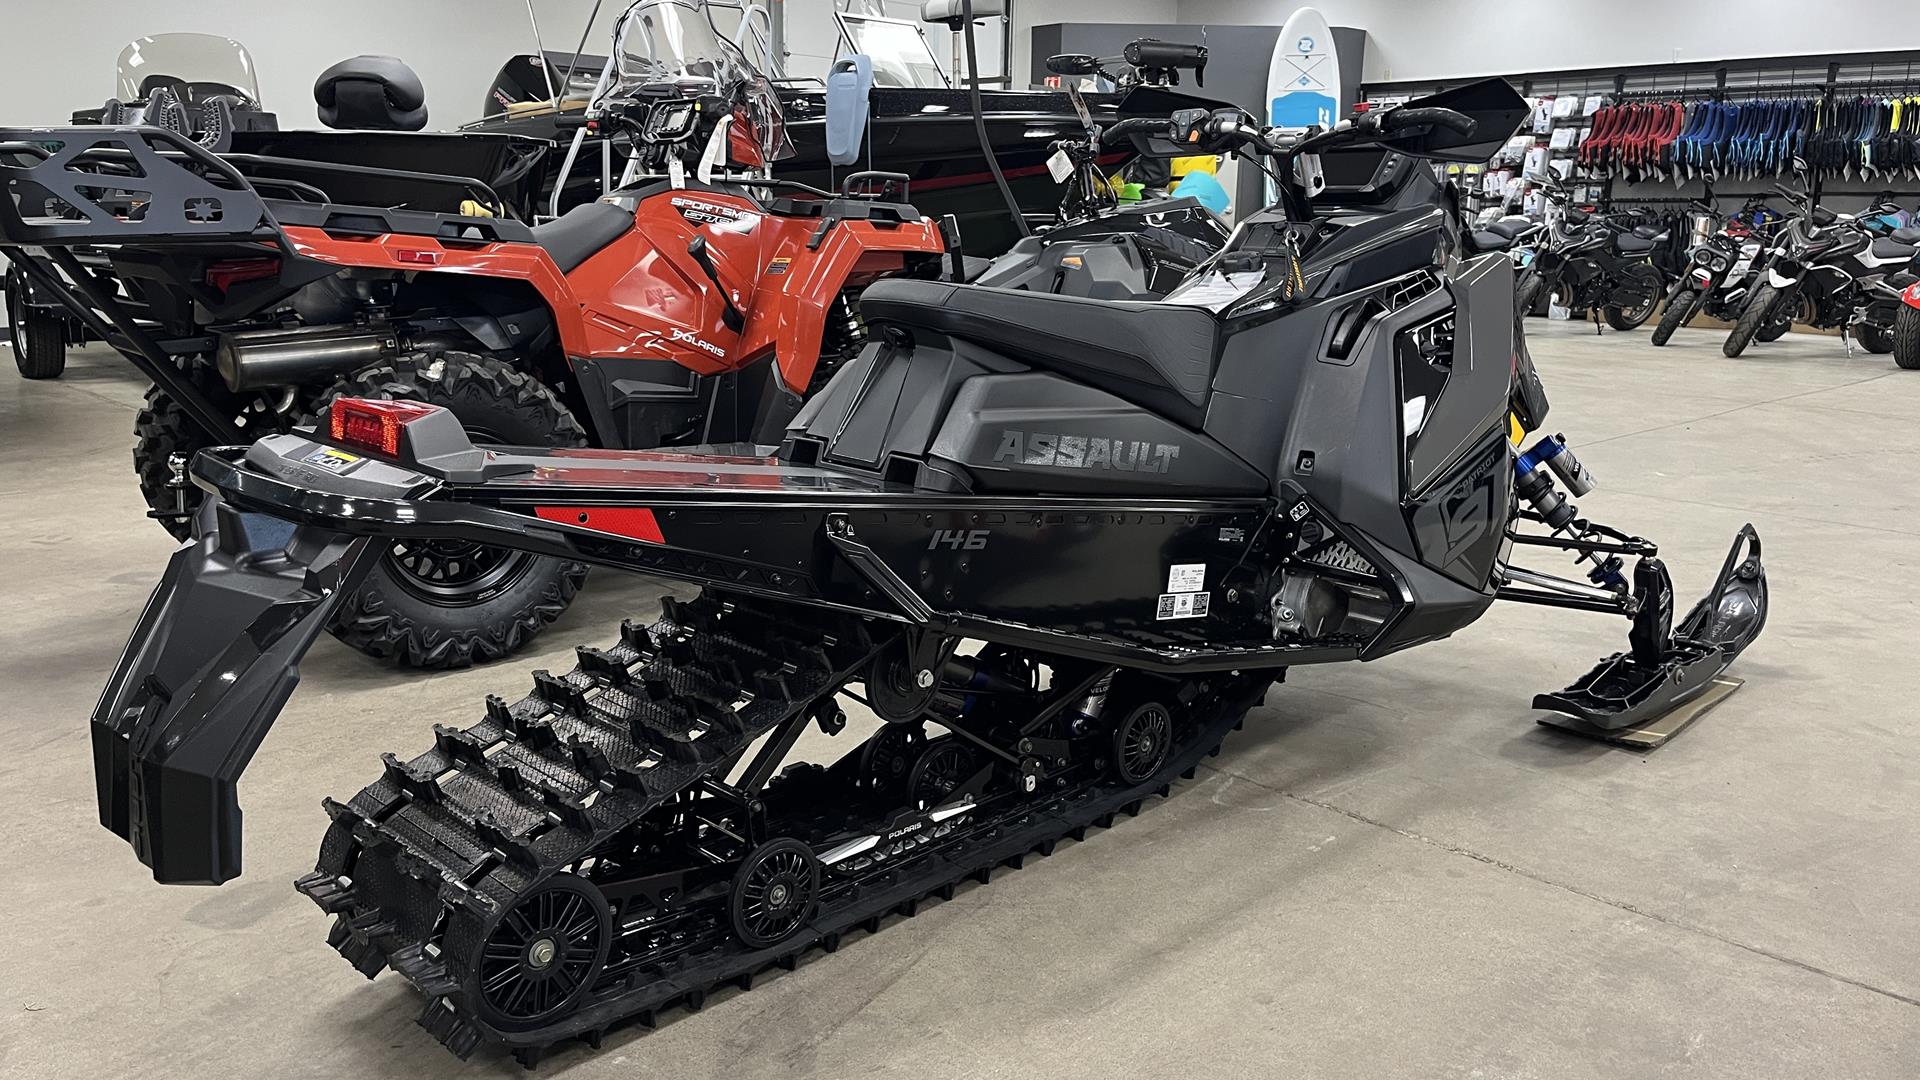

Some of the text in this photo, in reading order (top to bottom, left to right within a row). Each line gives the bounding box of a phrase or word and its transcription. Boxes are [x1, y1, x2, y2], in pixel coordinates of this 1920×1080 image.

[671, 197, 761, 222] SPORTSMA
[672, 328, 725, 357] POLARIS
[992, 430, 1181, 474] ASSAULT
[1461, 454, 1497, 488] PATRIOT
[927, 529, 991, 550] 146
[888, 821, 922, 840] POLARIS
